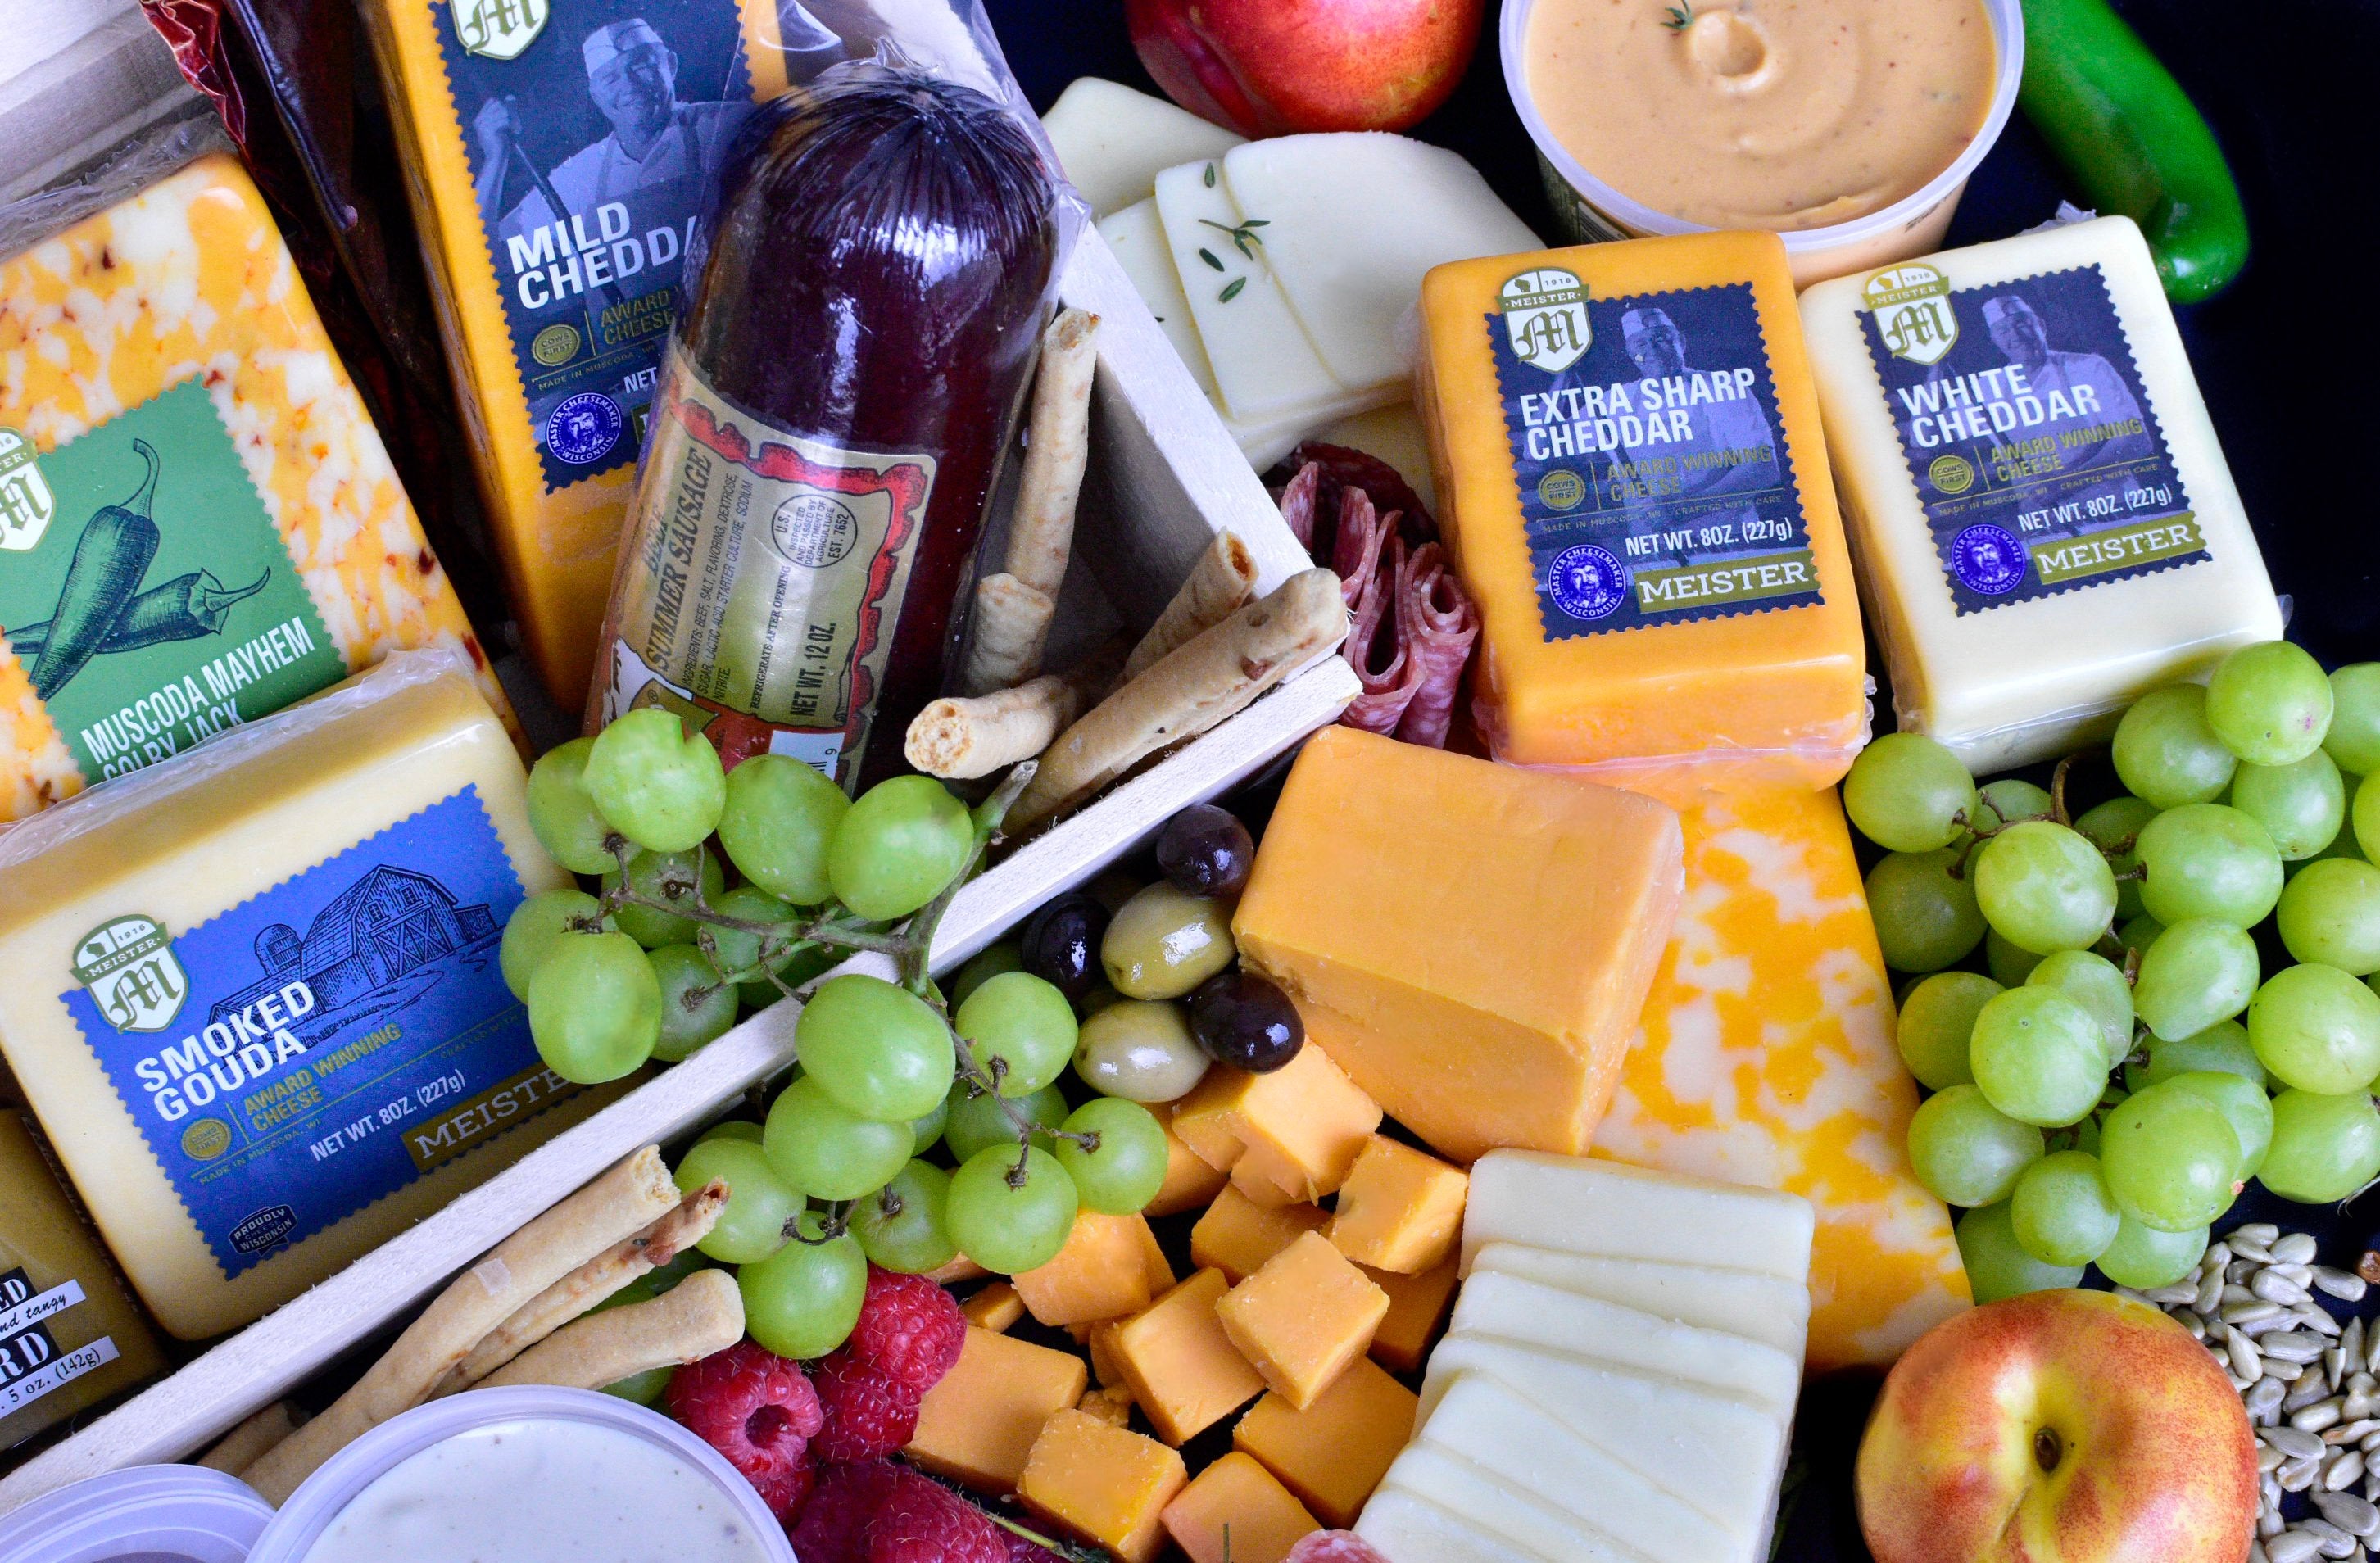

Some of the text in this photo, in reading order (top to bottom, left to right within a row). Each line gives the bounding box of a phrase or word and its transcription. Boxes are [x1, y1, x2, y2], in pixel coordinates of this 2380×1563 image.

[507, 202, 630, 274] MILD
[518, 215, 696, 309] CHEDD
[601, 289, 669, 327] AWARD
[1510, 292, 1576, 307] MEISTER
[1876, 285, 1937, 304] MEISTER
[541, 330, 570, 347] COWS
[544, 342, 572, 357] FIRST
[538, 375, 567, 391] MADE
[571, 370, 583, 379] IN
[623, 367, 657, 393] NET
[1520, 368, 1756, 427] EXTRA SHARP
[1897, 363, 2032, 416] WHITE
[550, 411, 564, 448] MASTER
[563, 396, 618, 427] CHEESEMAKER
[1527, 409, 1694, 461] CHEDDAR
[1911, 383, 2102, 448] CHEDDAR
[562, 436, 614, 460] WISCONSIN
[1991, 419, 2143, 464] AWARD WINNING
[1546, 479, 1575, 490] COWS
[1607, 445, 1774, 482] AWARD WINNING
[1936, 464, 1963, 474] COWS
[1939, 473, 1966, 486] FIRST
[1996, 454, 2065, 482] CHEESE
[736, 479, 753, 516] SODIUM
[1548, 490, 1575, 500] FIRST
[1610, 476, 1682, 501] CHEESE
[1939, 504, 1965, 516] MADE
[1969, 501, 1979, 510] IN
[2060, 475, 2103, 491] CRAFTED
[2106, 468, 2131, 480] WITH
[2133, 464, 2159, 474] CARE
[2017, 509, 2051, 532] NET
[2052, 502, 2086, 523] WT.
[2124, 482, 2172, 511] (227g)
[705, 525, 727, 575] FLAVORING,
[717, 473, 737, 523] DEXTROSE,
[775, 514, 791, 533] U.S.
[789, 506, 805, 550] INSPECTED
[797, 499, 817, 562] AND PASSED BY
[805, 501, 827, 565] DEPARTMENT OF
[816, 507, 835, 563] AGRICULTURE
[1543, 522, 1571, 532] MADE
[1575, 520, 1586, 528] IN
[1675, 504, 1720, 515] CRAFTED
[1725, 499, 1753, 509] WITH
[1756, 495, 1782, 505] CARE
[726, 519, 746, 562] CULTURE,
[828, 514, 849, 559] EST. 7652
[1625, 534, 1659, 556] NET
[1663, 529, 1698, 551] WT.
[1742, 517, 1793, 544] (227g)
[1954, 527, 2022, 574] MASTER CHEESEMAKER
[2037, 524, 2193, 574] MEISTER
[646, 446, 712, 672] SUMMER SAUSAGE
[1552, 547, 1623, 596] MASTER CHEESEMAKER
[717, 563, 735, 604] STARTER
[1639, 561, 1809, 604] MEISTER
[1970, 571, 2020, 591] WISCONSIN
[712, 605, 725, 628] ACID
[1564, 597, 1618, 616] WISCONSIN
[705, 628, 721, 660] LACTIC
[750, 565, 791, 709] REFRIGERATE AFTER OPENING
[80, 616, 315, 764] MUSCODA MAYHEM
[713, 667, 731, 701] NITRITE
[790, 623, 836, 717] NET WT. 12 OZ.
[117, 923, 146, 942] 1916
[88, 938, 157, 977] MEISTER
[135, 981, 315, 1092] SMOKED
[154, 1028, 308, 1121] GOUDA
[245, 1022, 403, 1115] AWARD WINNING
[252, 1085, 324, 1131] CHEESE
[309, 1130, 348, 1161] NET
[344, 1114, 380, 1142] WT.
[416, 1068, 466, 1108] (227g)
[414, 1067, 569, 1159] MEISTE
[200, 1165, 230, 1185] MADE
[233, 1208, 285, 1240] PROUDLY
[239, 1218, 292, 1250] WISCONSIN
[0, 1312, 20, 1333] nd
[26, 1293, 67, 1319] tangy
[0, 1332, 49, 1385] RD
[8, 1347, 101, 1403] 5 oz. (142g)
